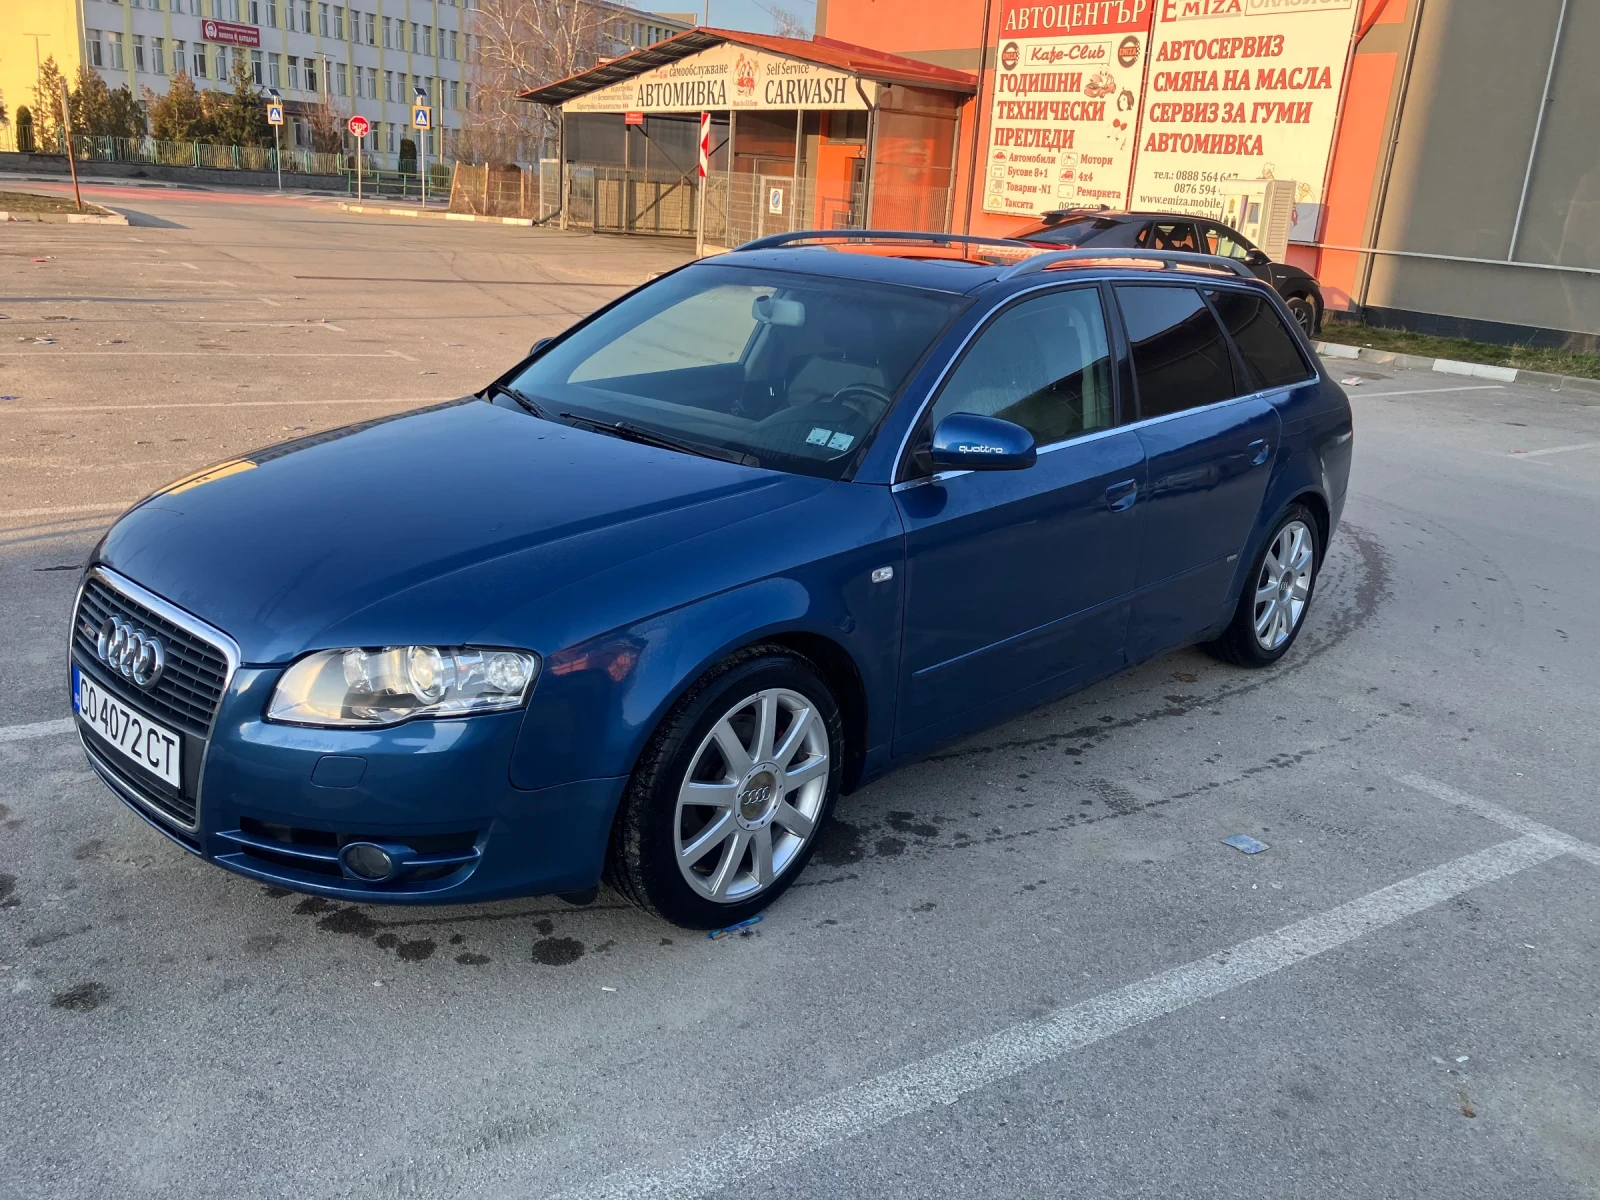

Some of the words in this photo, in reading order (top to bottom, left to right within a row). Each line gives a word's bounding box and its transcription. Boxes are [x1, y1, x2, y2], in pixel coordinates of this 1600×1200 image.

[1004, 0, 1147, 32] АВТОЦЕНТЪР
[1030, 44, 1105, 64] Kafe-Club
[1156, 34, 1284, 62] АВТОСЕРВИЗ
[766, 62, 780, 75] Self
[781, 62, 810, 75] Service
[999, 72, 1082, 97] ГОДИШНИ
[1154, 70, 1218, 92] СМЯНА
[1222, 69, 1250, 90] НА
[1255, 66, 1332, 90] МАСЛА
[636, 79, 727, 107] АВТОМИВКА
[765, 78, 848, 104] CARWASH
[997, 101, 1106, 121] ТЕХНИЧЕСКИ
[1150, 102, 1219, 122] СЕРВИЗ
[1222, 102, 1246, 123] ЗА
[1250, 102, 1313, 124] ГУМИ
[351, 122, 367, 130] STOP
[994, 128, 1075, 152] ПРЕГЛЕДИ
[1144, 132, 1264, 156] АВТОМИВКА
[1008, 153, 1056, 164] Автомобили
[1080, 154, 1113, 167] Мотори
[1007, 166, 1032, 179] Бусове
[1034, 168, 1048, 178] 8+1
[1176, 170, 1199, 181] 0888
[1201, 172, 1218, 182] 564
[1006, 182, 1037, 194] Товарни
[1077, 187, 1121, 200] Ремаркета
[1174, 183, 1197, 194] 0876
[1199, 184, 1216, 195] 594
[1004, 198, 1034, 209] Таксита
[1140, 194, 1224, 209] www.emiza.mobile.
[959, 445, 1003, 454] quattro
[100, 697, 142, 758] 4072
